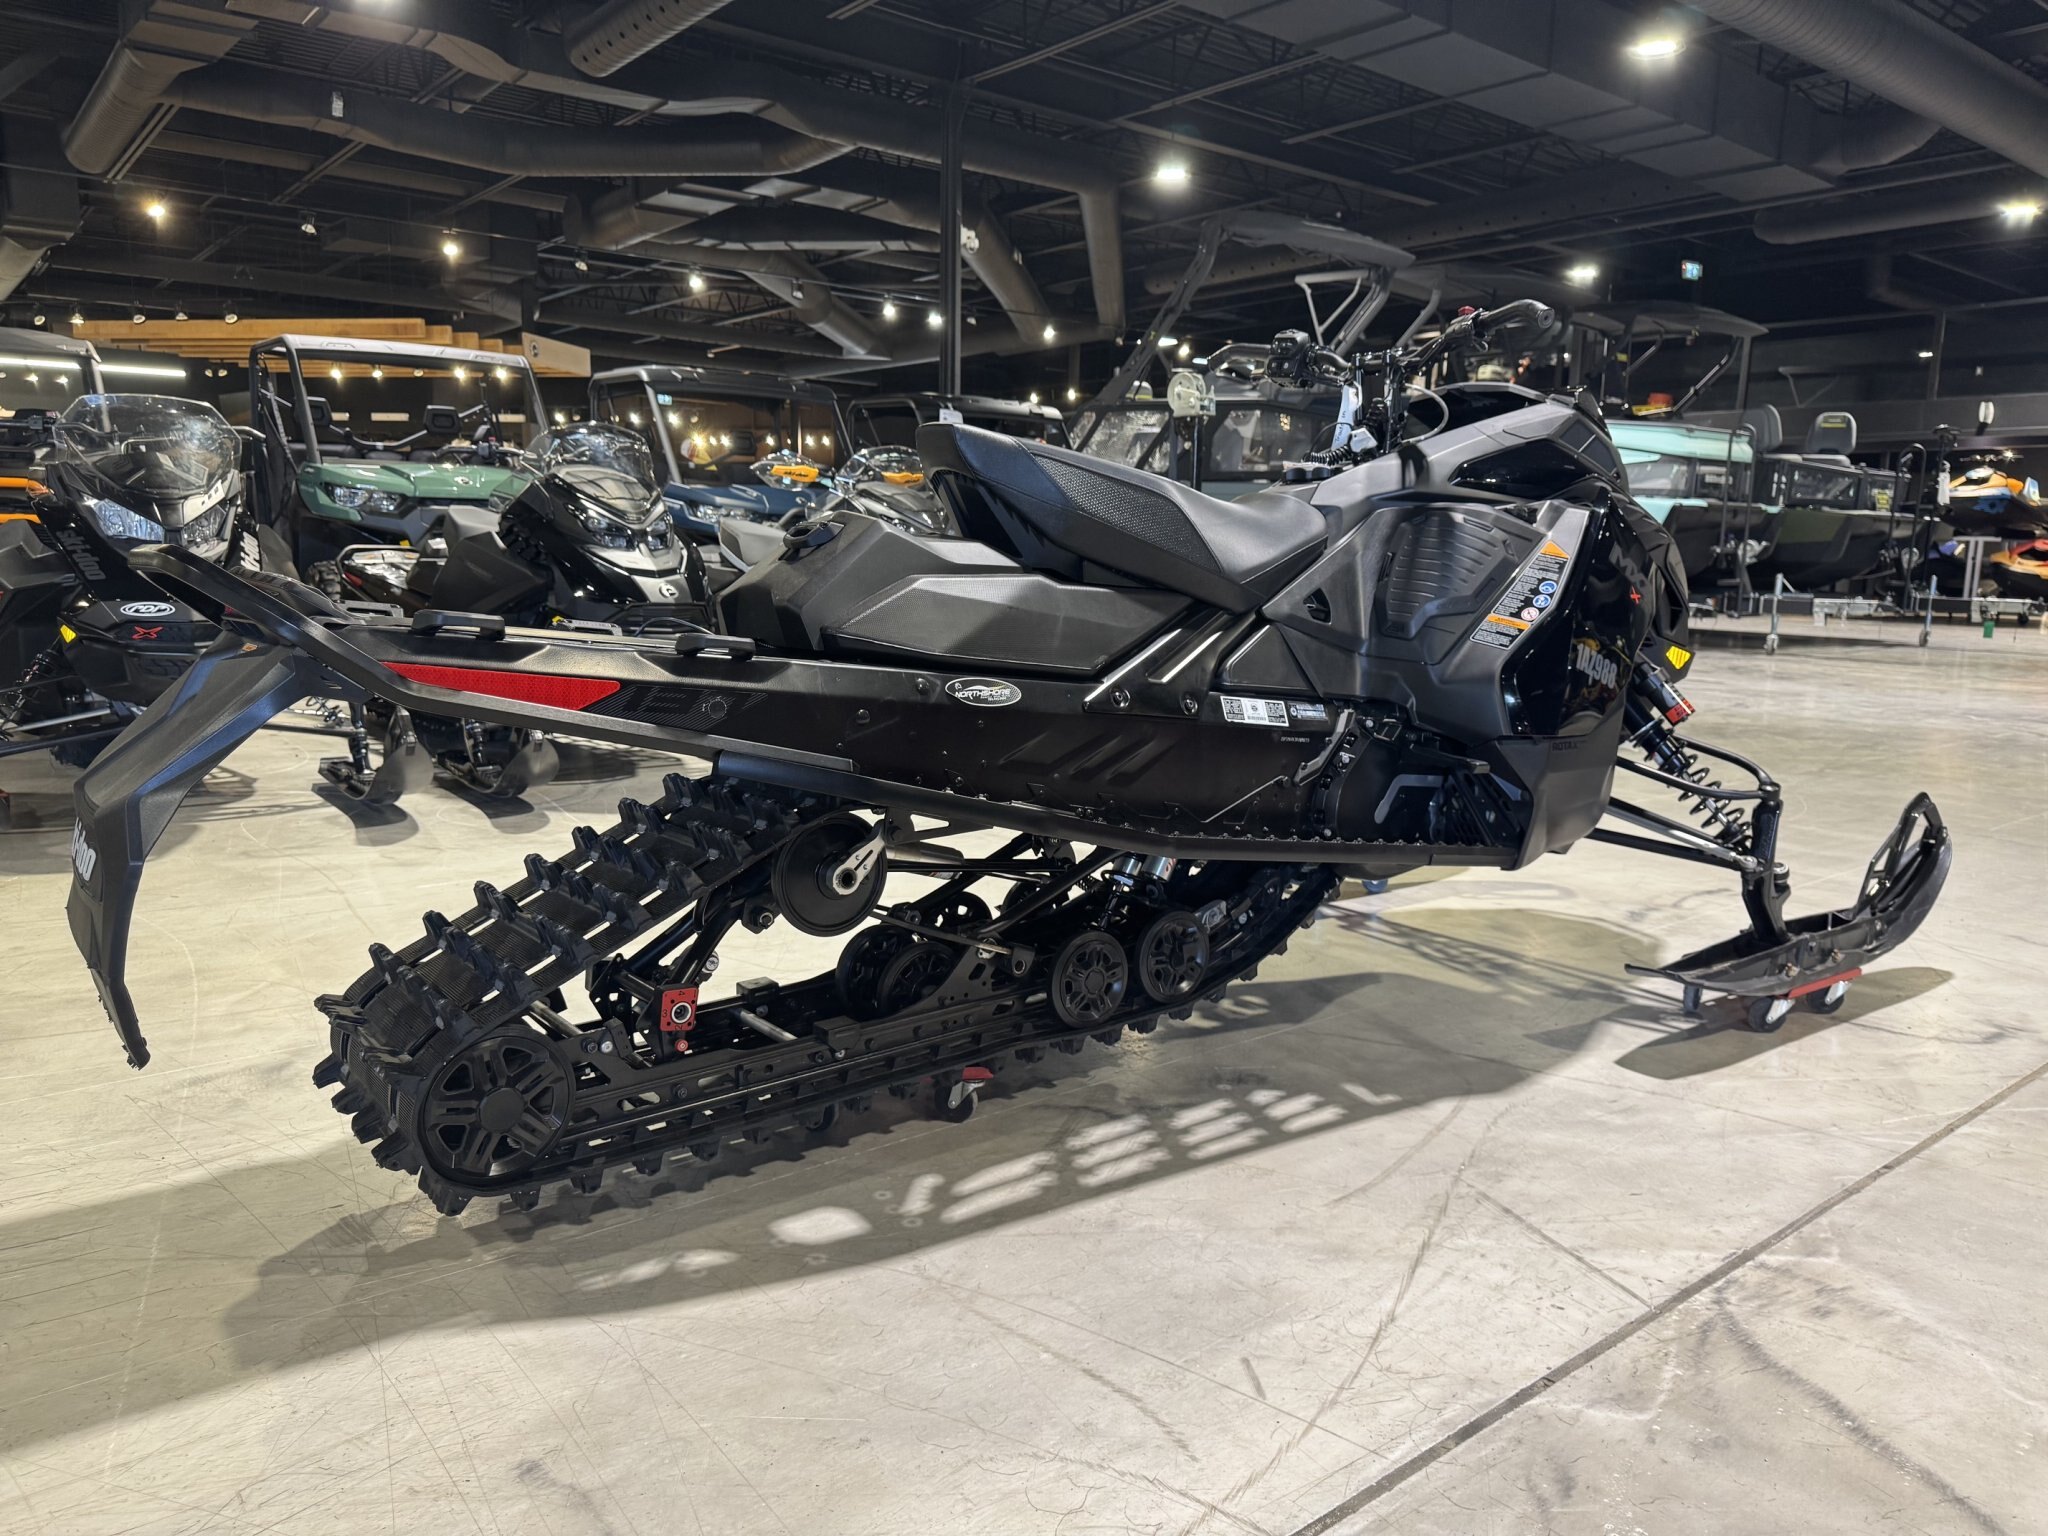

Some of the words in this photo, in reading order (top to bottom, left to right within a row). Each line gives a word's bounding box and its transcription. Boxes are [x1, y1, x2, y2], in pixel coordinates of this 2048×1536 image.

[56, 530, 106, 580] ski-doo
[240, 531, 260, 572] ki-doo
[955, 688, 1011, 700] NORTHSHORE
